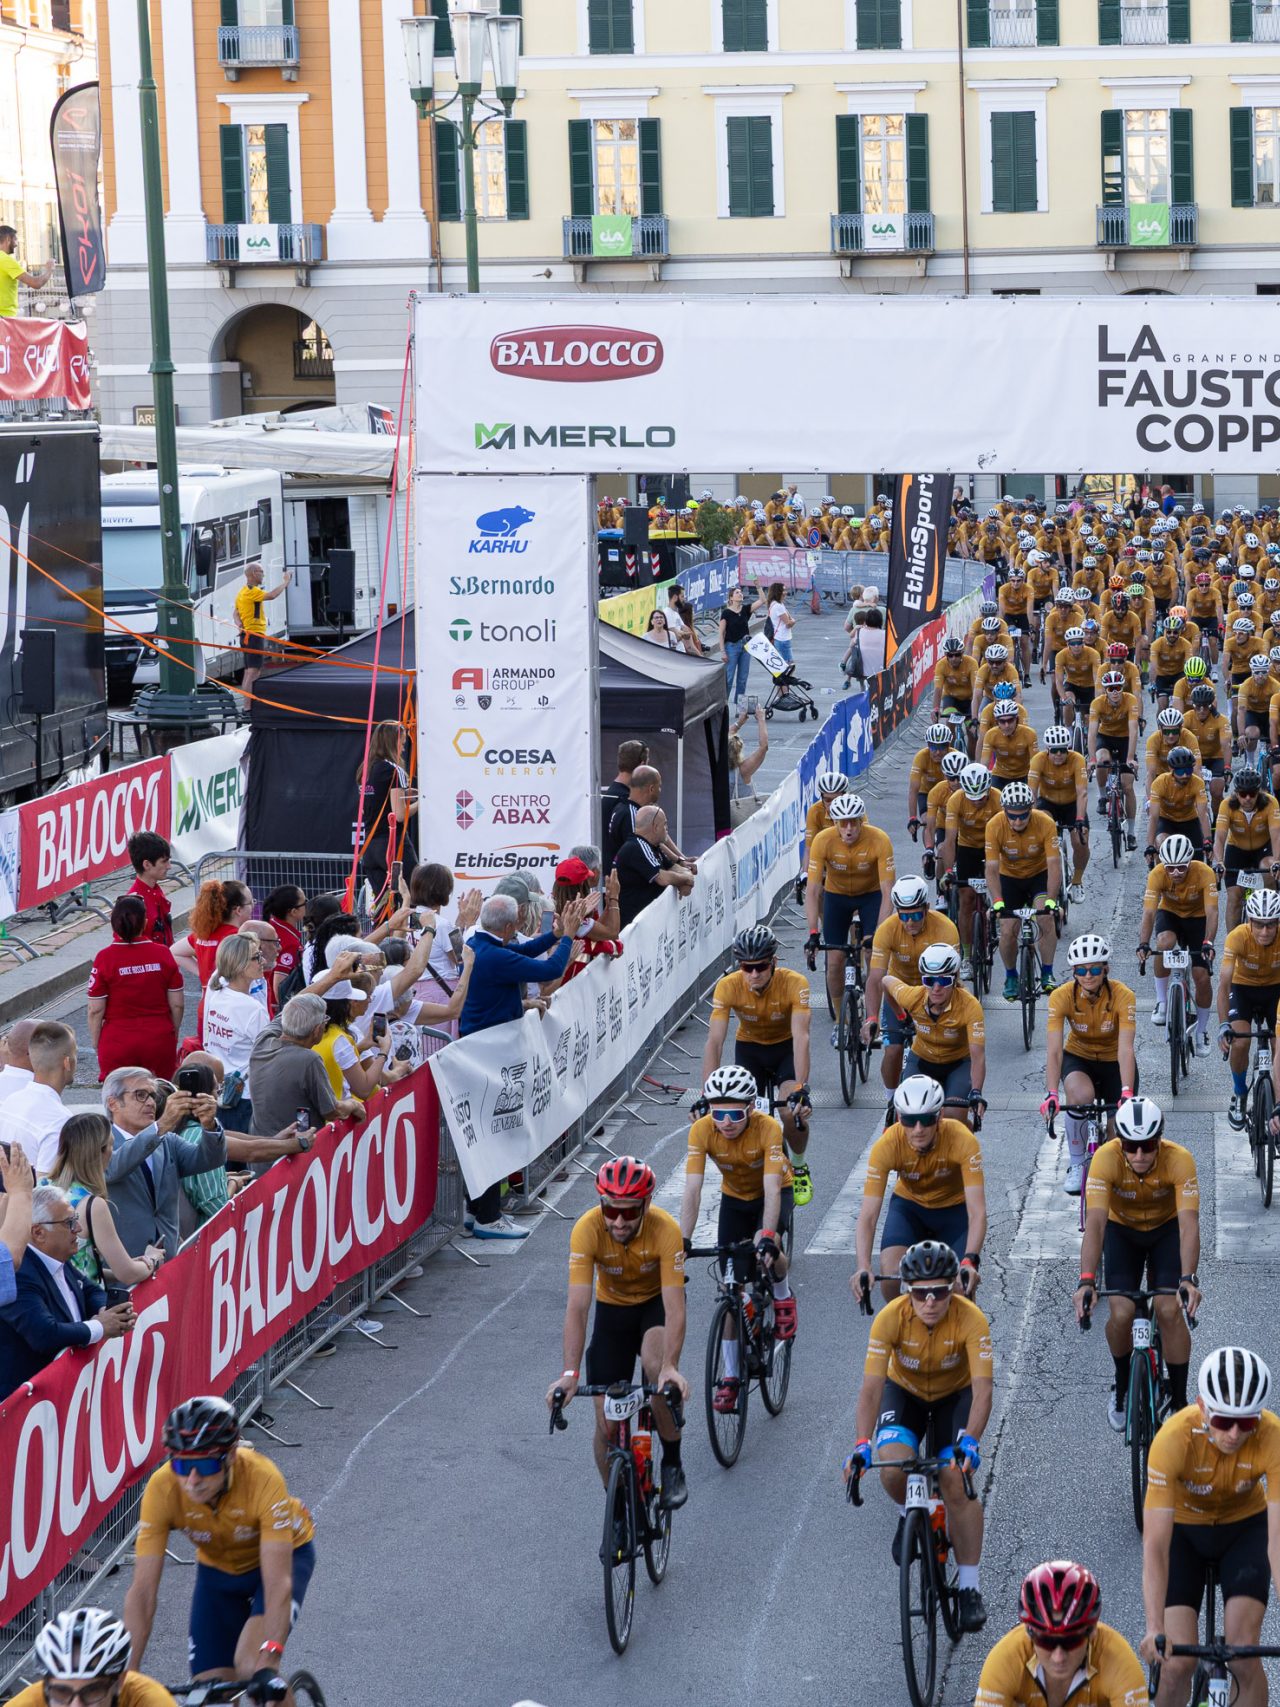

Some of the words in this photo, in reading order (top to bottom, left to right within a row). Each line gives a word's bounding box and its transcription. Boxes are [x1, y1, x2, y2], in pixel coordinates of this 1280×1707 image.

[1098, 324, 1166, 362] LA
[496, 341, 657, 366] BALOCCO
[524, 425, 676, 448] MERLO
[468, 540, 528, 553] KARHU
[450, 576, 555, 596] S.Bernardo
[481, 619, 556, 642] tonoli
[493, 668, 555, 678] ARMANDO
[492, 680, 535, 690] GROUP
[484, 749, 556, 765] COESA
[492, 795, 550, 807] CENTRO
[492, 809, 550, 824] ABAX
[37, 769, 163, 890] BALOCCO
[455, 853, 560, 871] EthicSport
[208, 1022, 233, 1040] STAFF
[208, 1092, 416, 1382] BALOCCO
[1133, 1327, 1150, 1340] 753
[615, 1401, 636, 1414] 872
